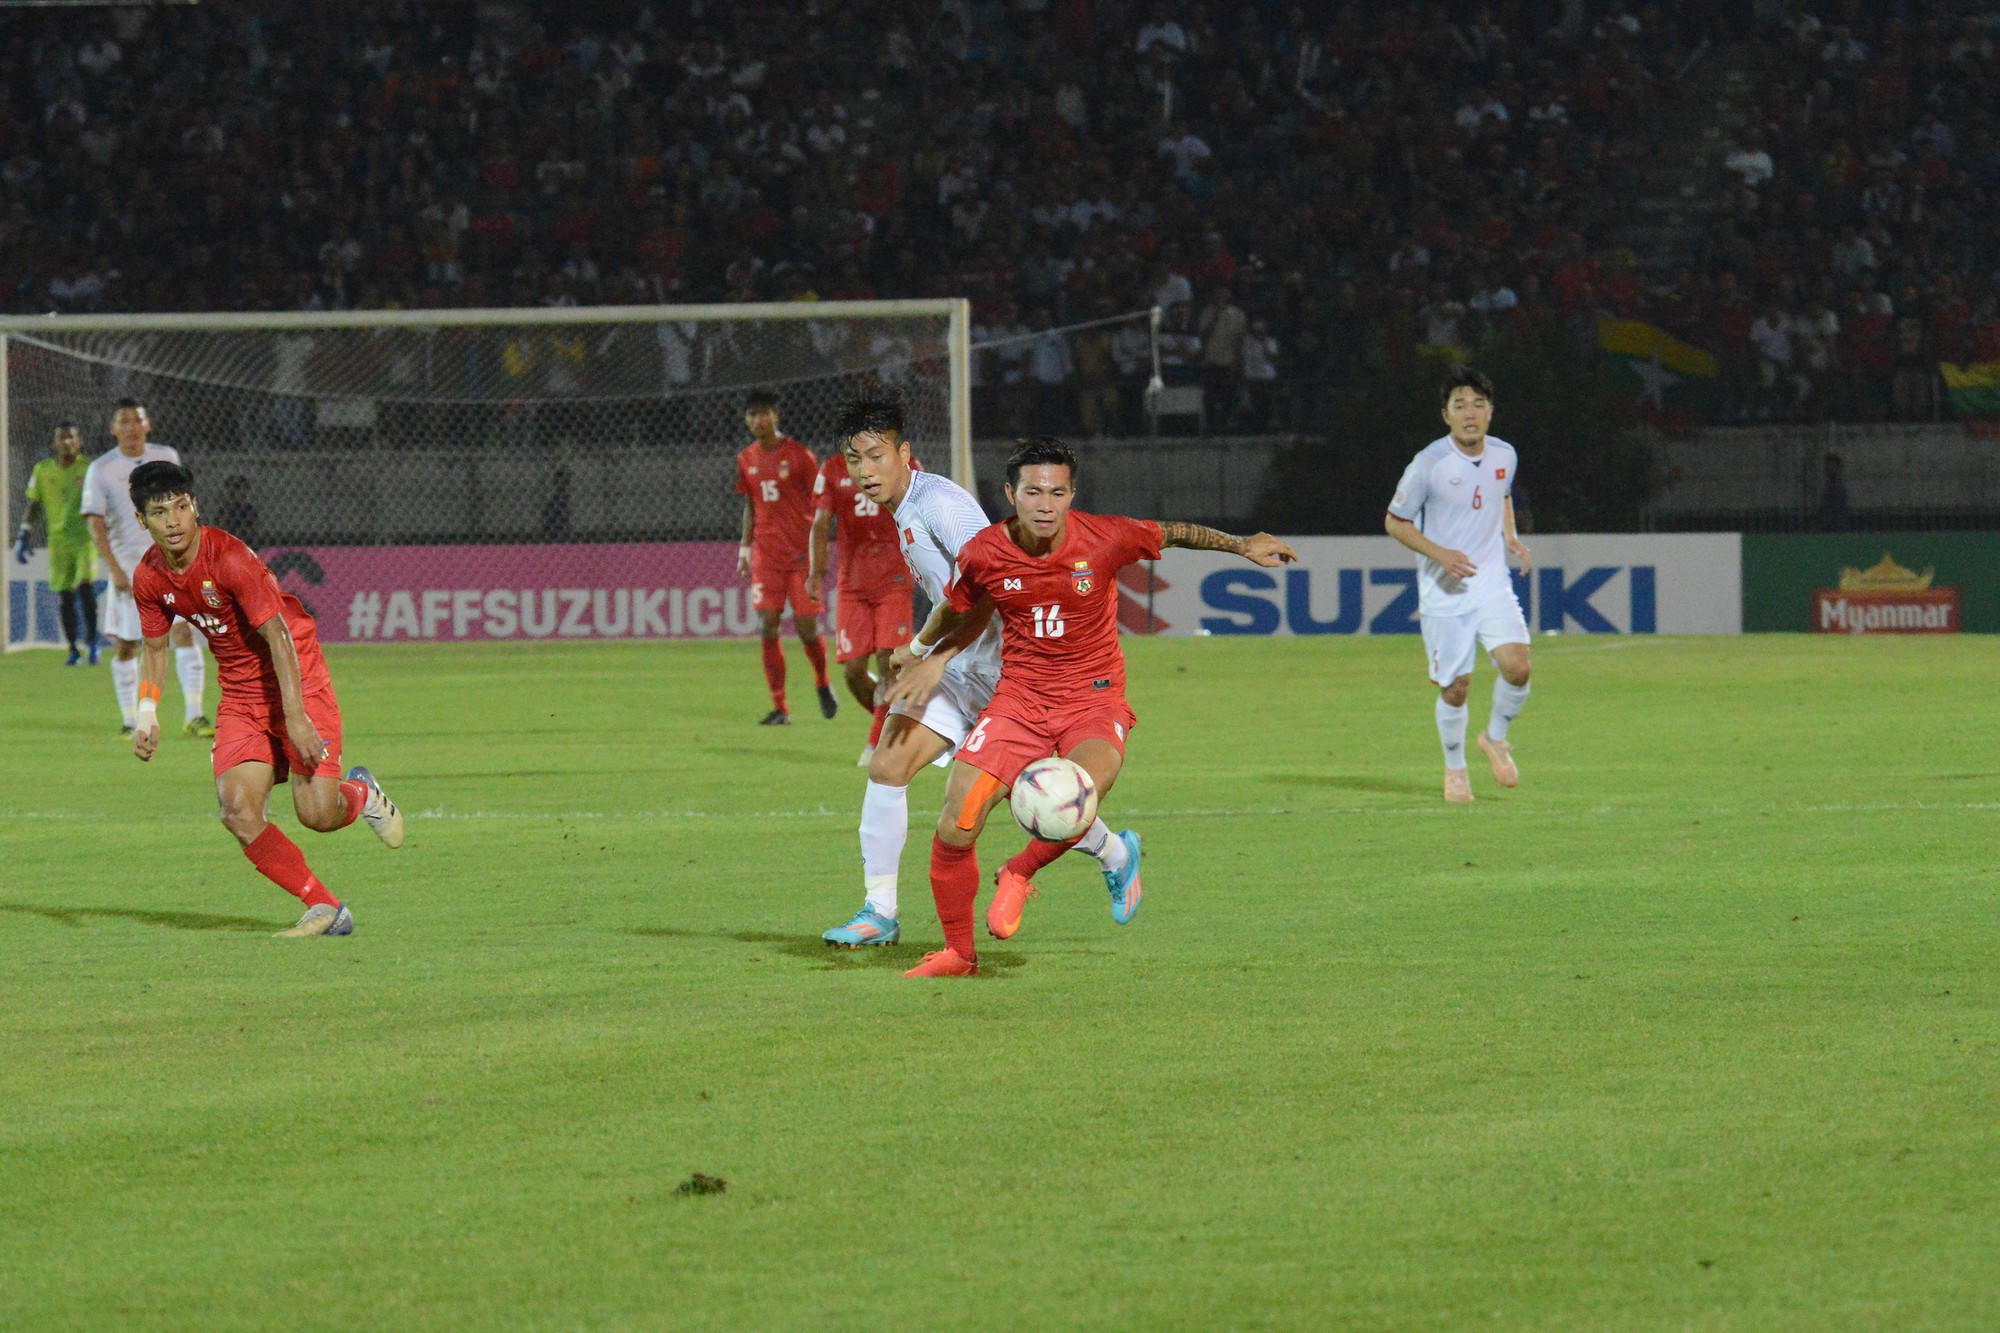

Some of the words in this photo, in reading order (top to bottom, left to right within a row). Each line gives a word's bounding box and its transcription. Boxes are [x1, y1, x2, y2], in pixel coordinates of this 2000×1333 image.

[760, 479, 780, 502] 15
[1472, 485, 1482, 510] 6
[1201, 567, 1656, 634] SUZKI
[1820, 598, 1953, 634] Myanmar
[1031, 604, 1065, 638] 16
